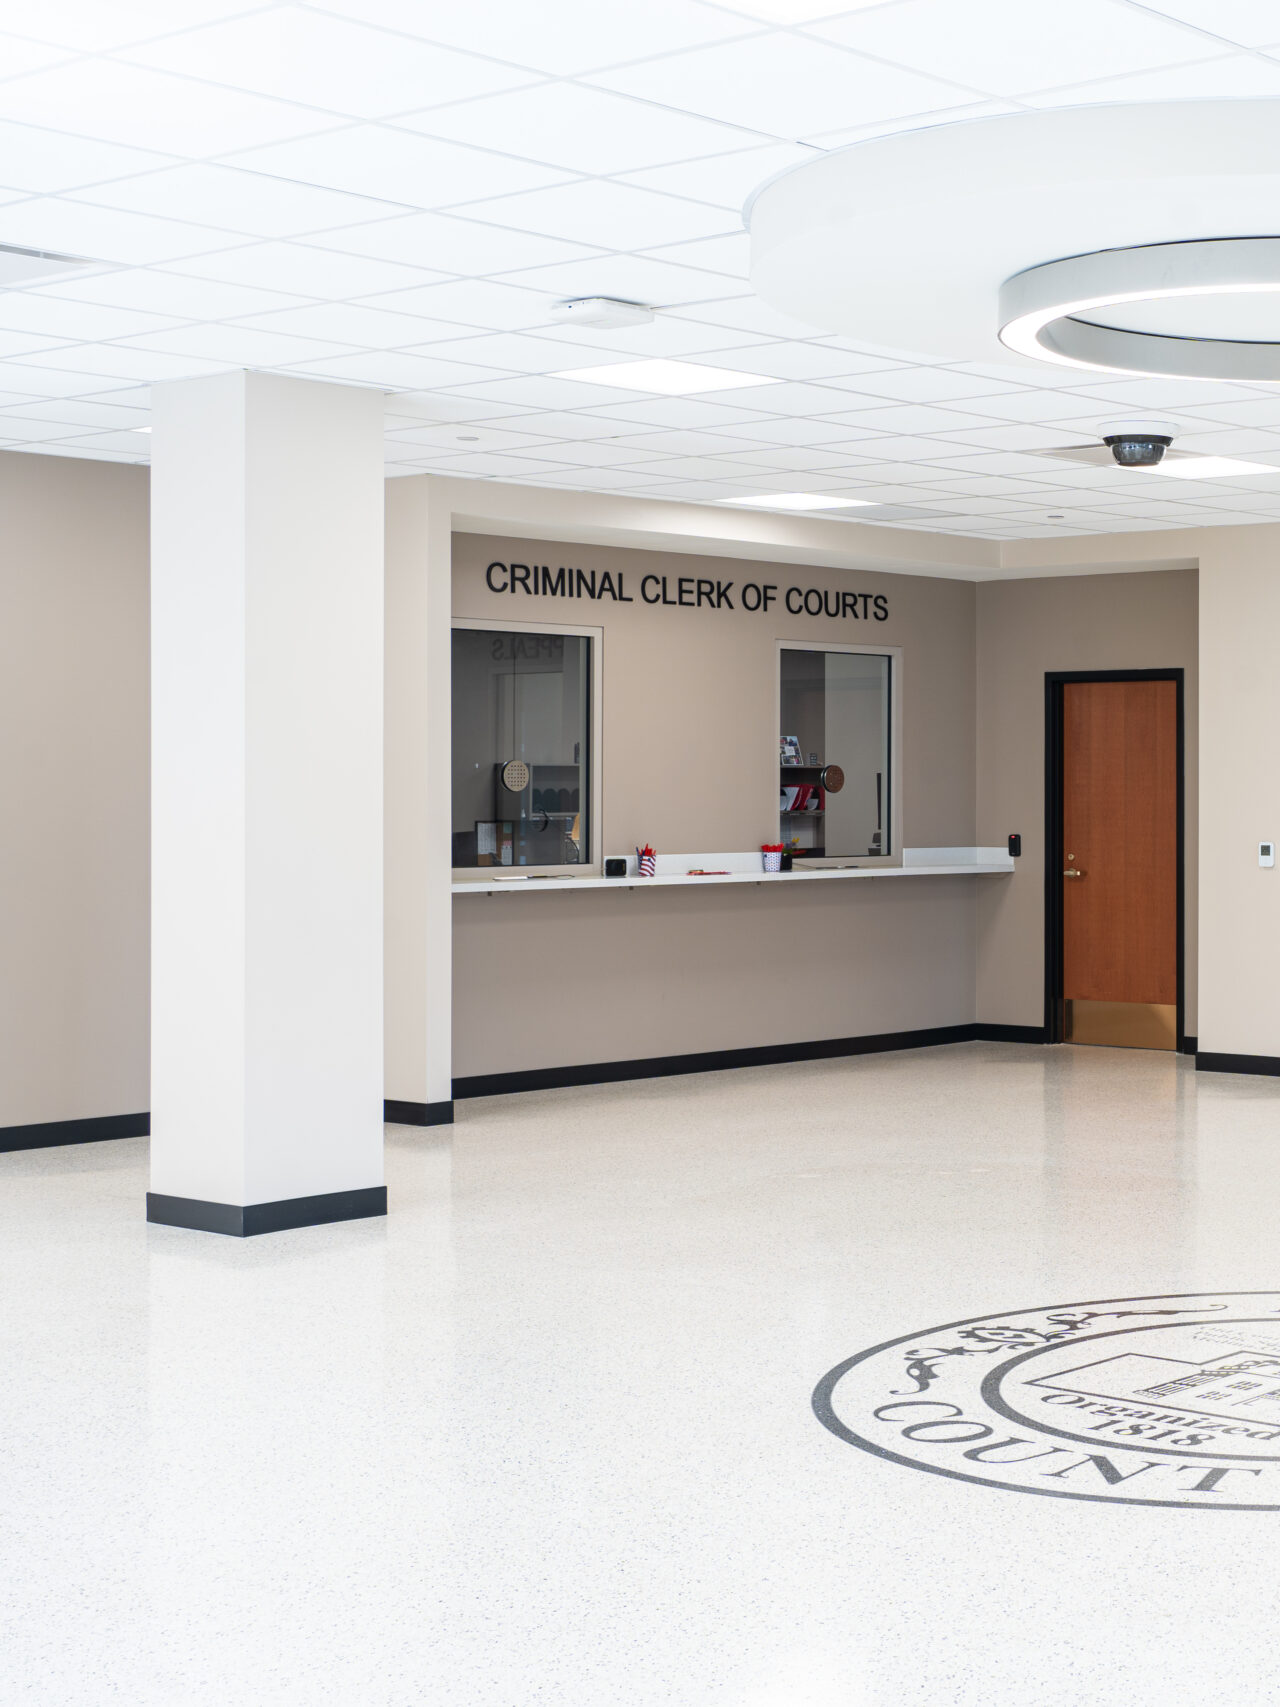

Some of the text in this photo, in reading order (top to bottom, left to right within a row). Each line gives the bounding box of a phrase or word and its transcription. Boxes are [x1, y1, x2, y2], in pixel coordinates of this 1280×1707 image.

[485, 561, 889, 622] CRIMINAL CLERK OF COURTS
[1086, 1419, 1216, 1447] 1818
